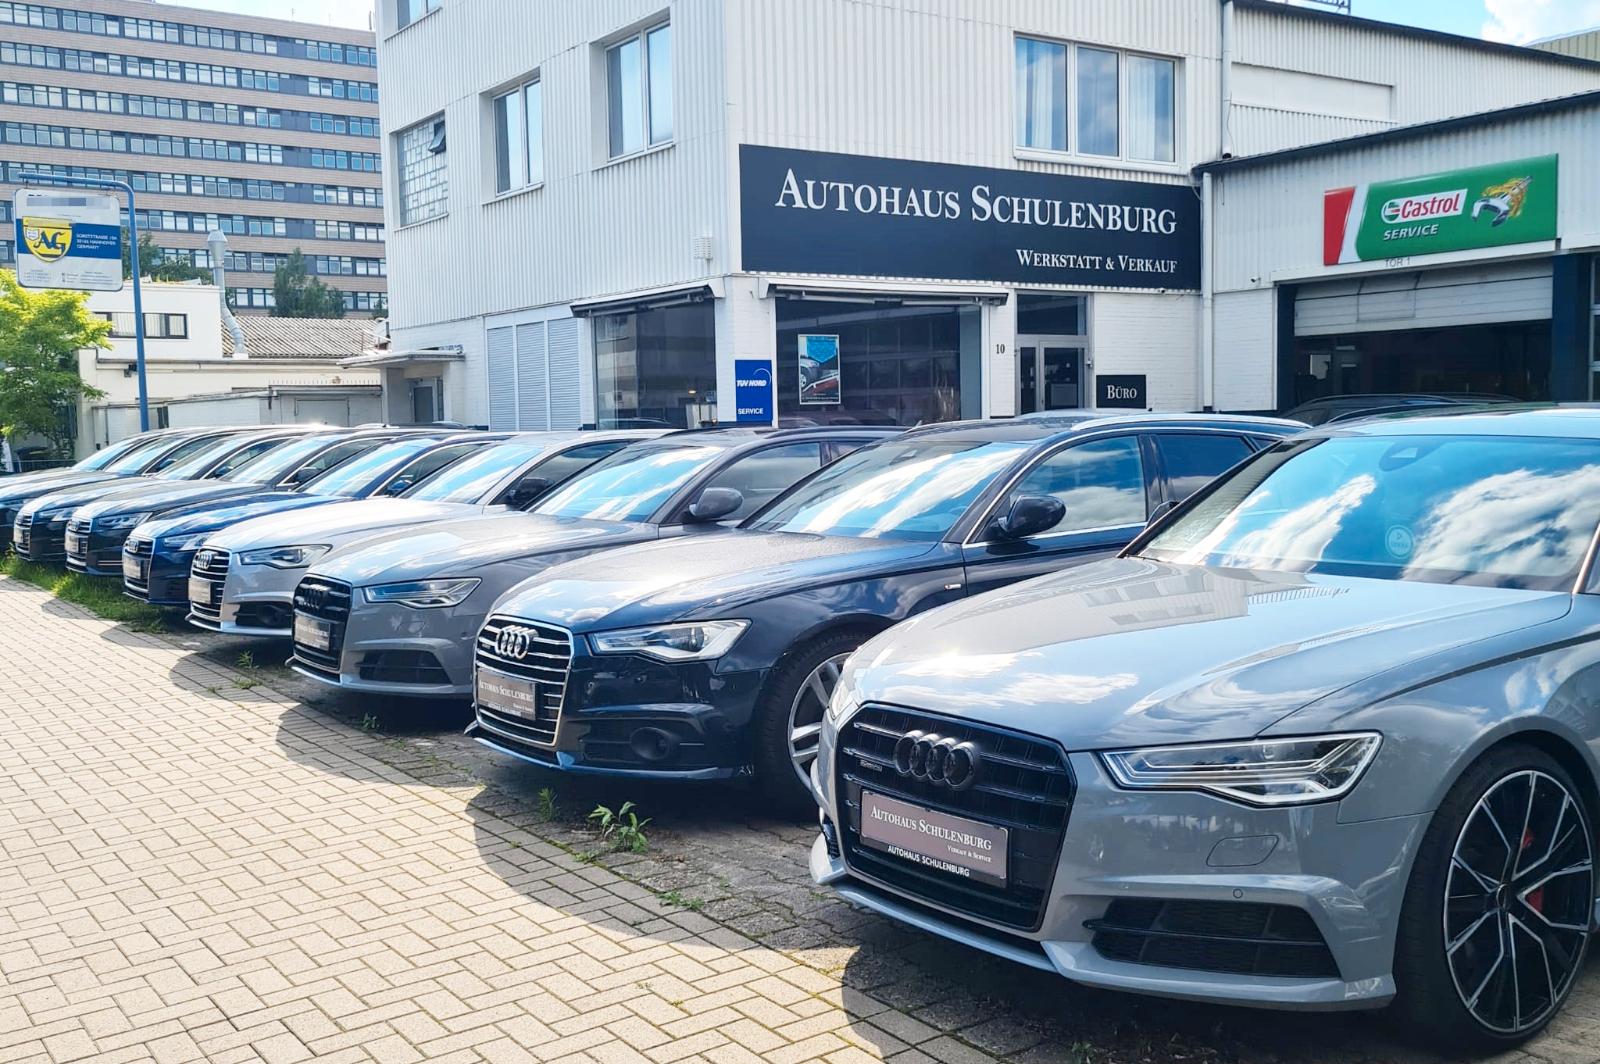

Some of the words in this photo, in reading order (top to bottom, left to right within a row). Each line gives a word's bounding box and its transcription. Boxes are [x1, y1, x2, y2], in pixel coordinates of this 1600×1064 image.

[775, 168, 961, 220] AUTOHAUS
[971, 185, 1178, 235] SCHULENBURG
[1401, 193, 1460, 219] Castrol
[1383, 224, 1439, 241] SERVICE
[1016, 249, 1102, 270] WERKSTATT
[1105, 257, 1115, 271] &
[1118, 255, 1178, 273] VERKAUF
[1385, 258, 1404, 268] TOR
[996, 343, 1005, 355] 10
[749, 379, 767, 387] NORD
[1107, 385, 1137, 399] BÜRO
[871, 806, 917, 830] AUTOHAUS
[919, 820, 992, 850] SCHULENBURG
[887, 845, 920, 862] AUTOHAUS
[921, 855, 970, 877] SCHULENBURG
